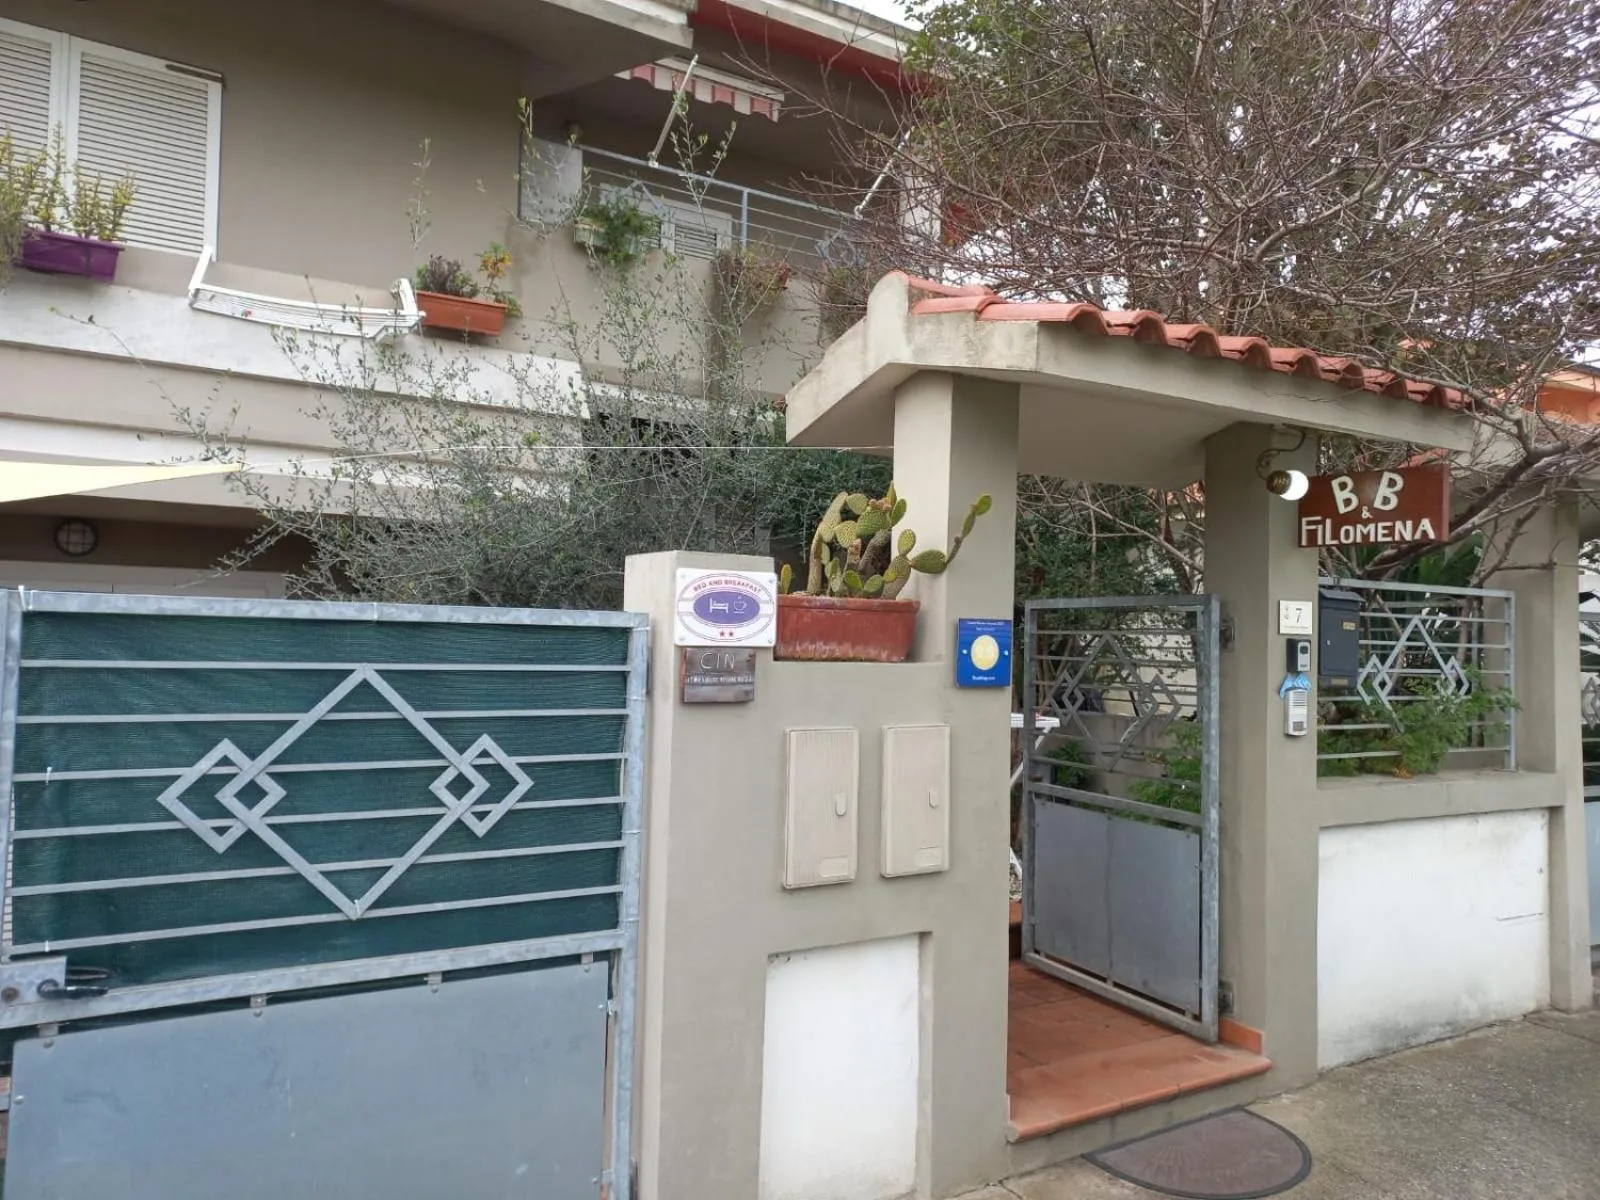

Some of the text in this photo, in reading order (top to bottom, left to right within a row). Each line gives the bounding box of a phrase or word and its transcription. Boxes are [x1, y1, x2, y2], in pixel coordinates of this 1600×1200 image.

[1331, 471, 1404, 519] B & B
[1301, 516, 1437, 546] FILOMENA
[693, 582, 707, 592] BED
[724, 579, 762, 594] BREAKFAST
[1295, 607, 1303, 624] 7
[700, 652, 735, 669] CIN
